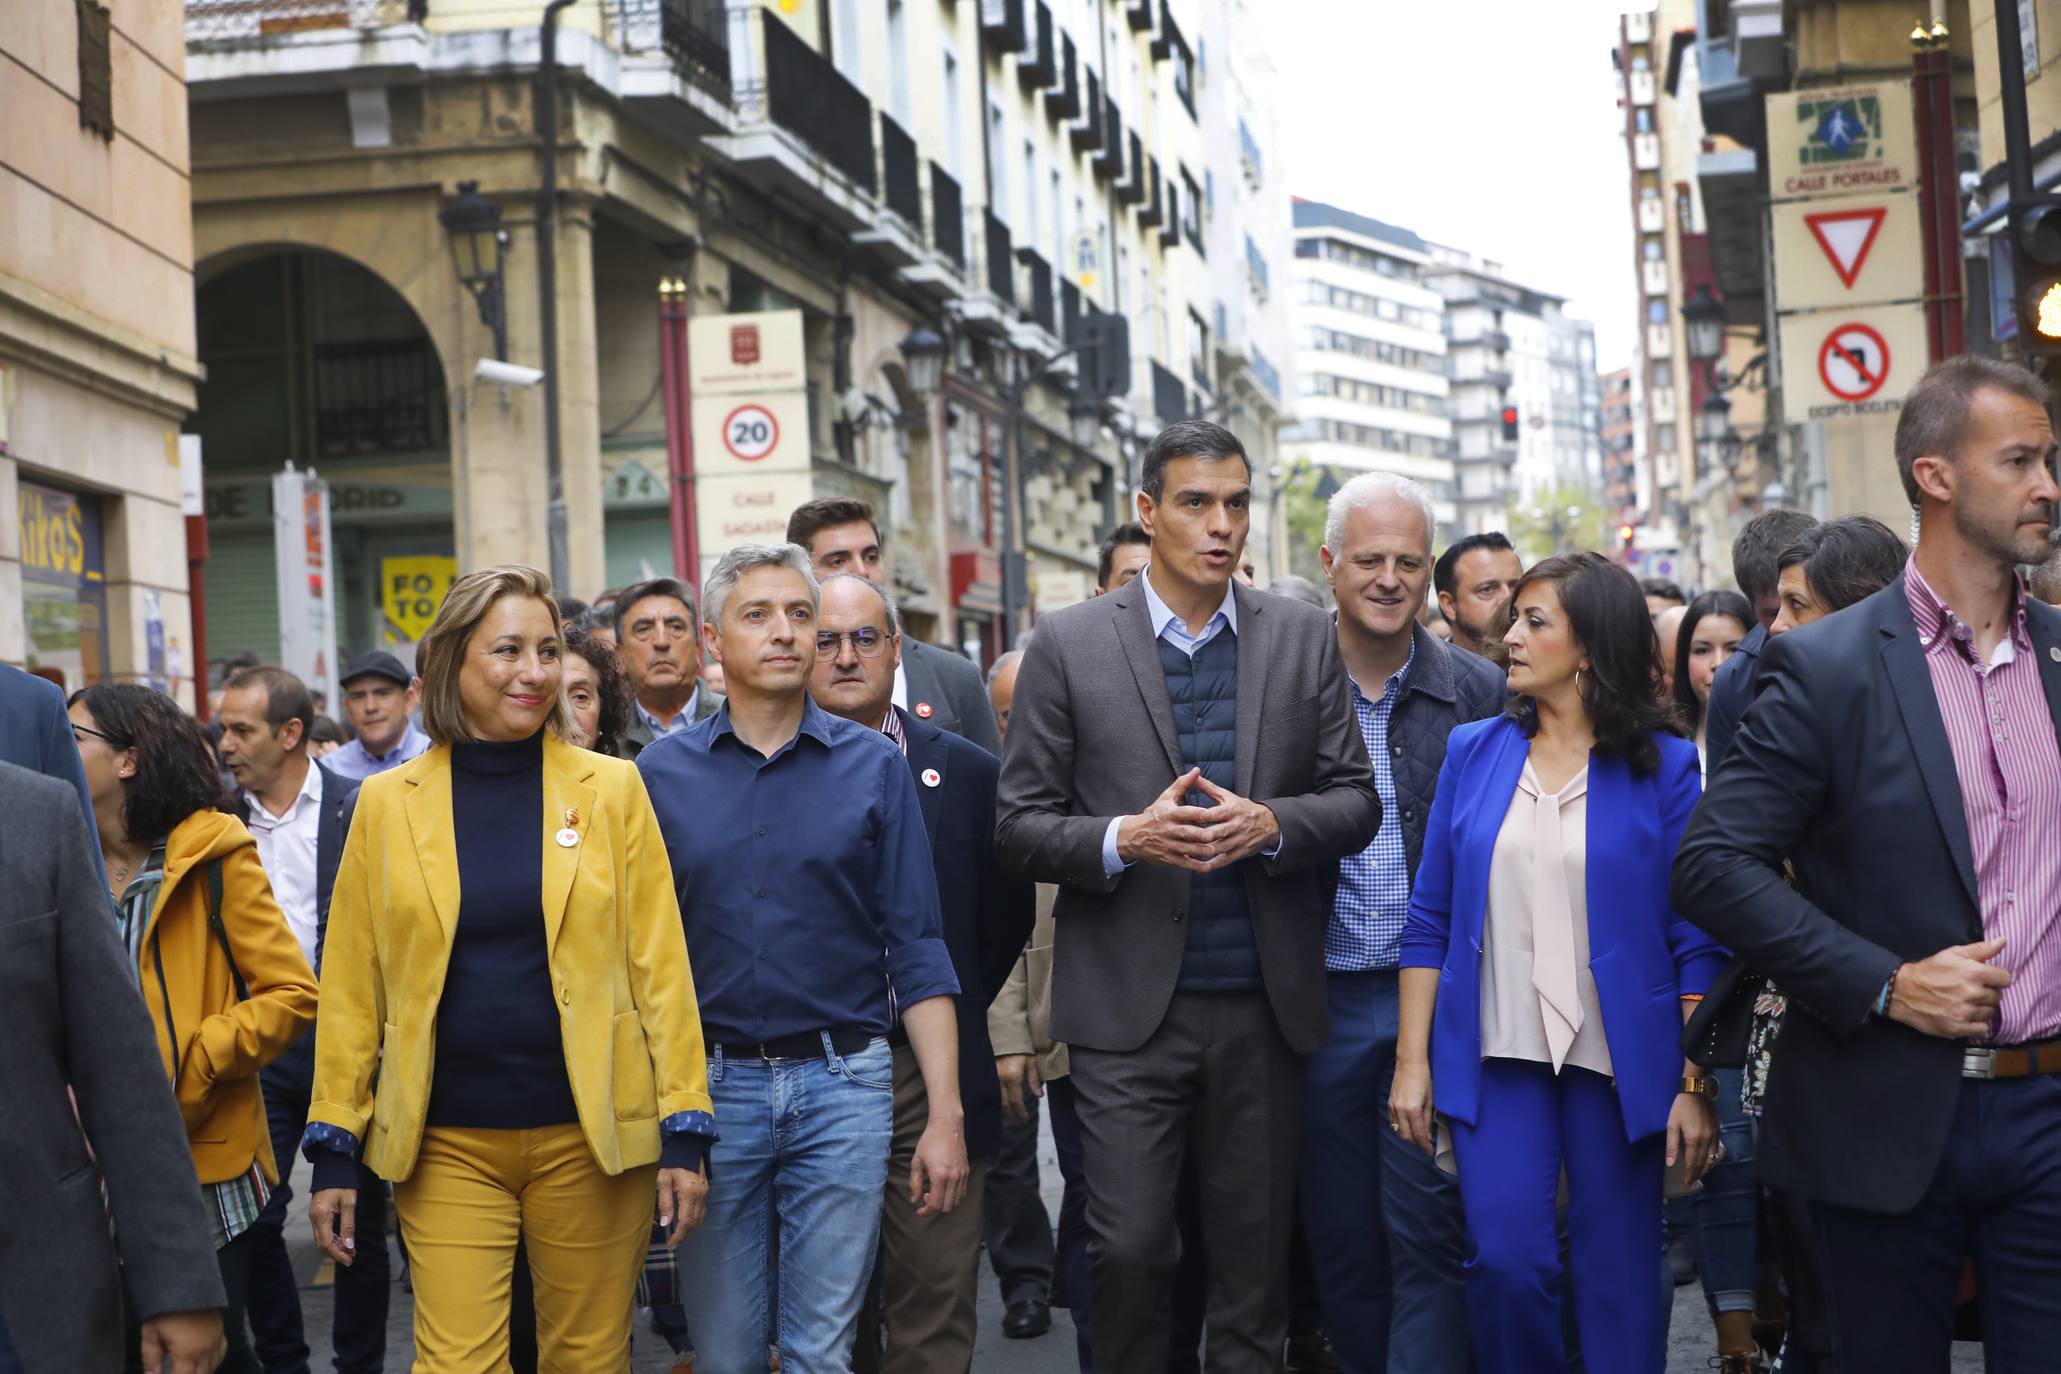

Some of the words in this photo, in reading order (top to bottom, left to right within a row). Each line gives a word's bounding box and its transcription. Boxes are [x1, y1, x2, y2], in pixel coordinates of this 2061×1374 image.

[1785, 176, 1826, 193] CALLE
[1832, 168, 1901, 187] PORTALES
[733, 421, 768, 445] 20
[732, 492, 775, 508] CALLE
